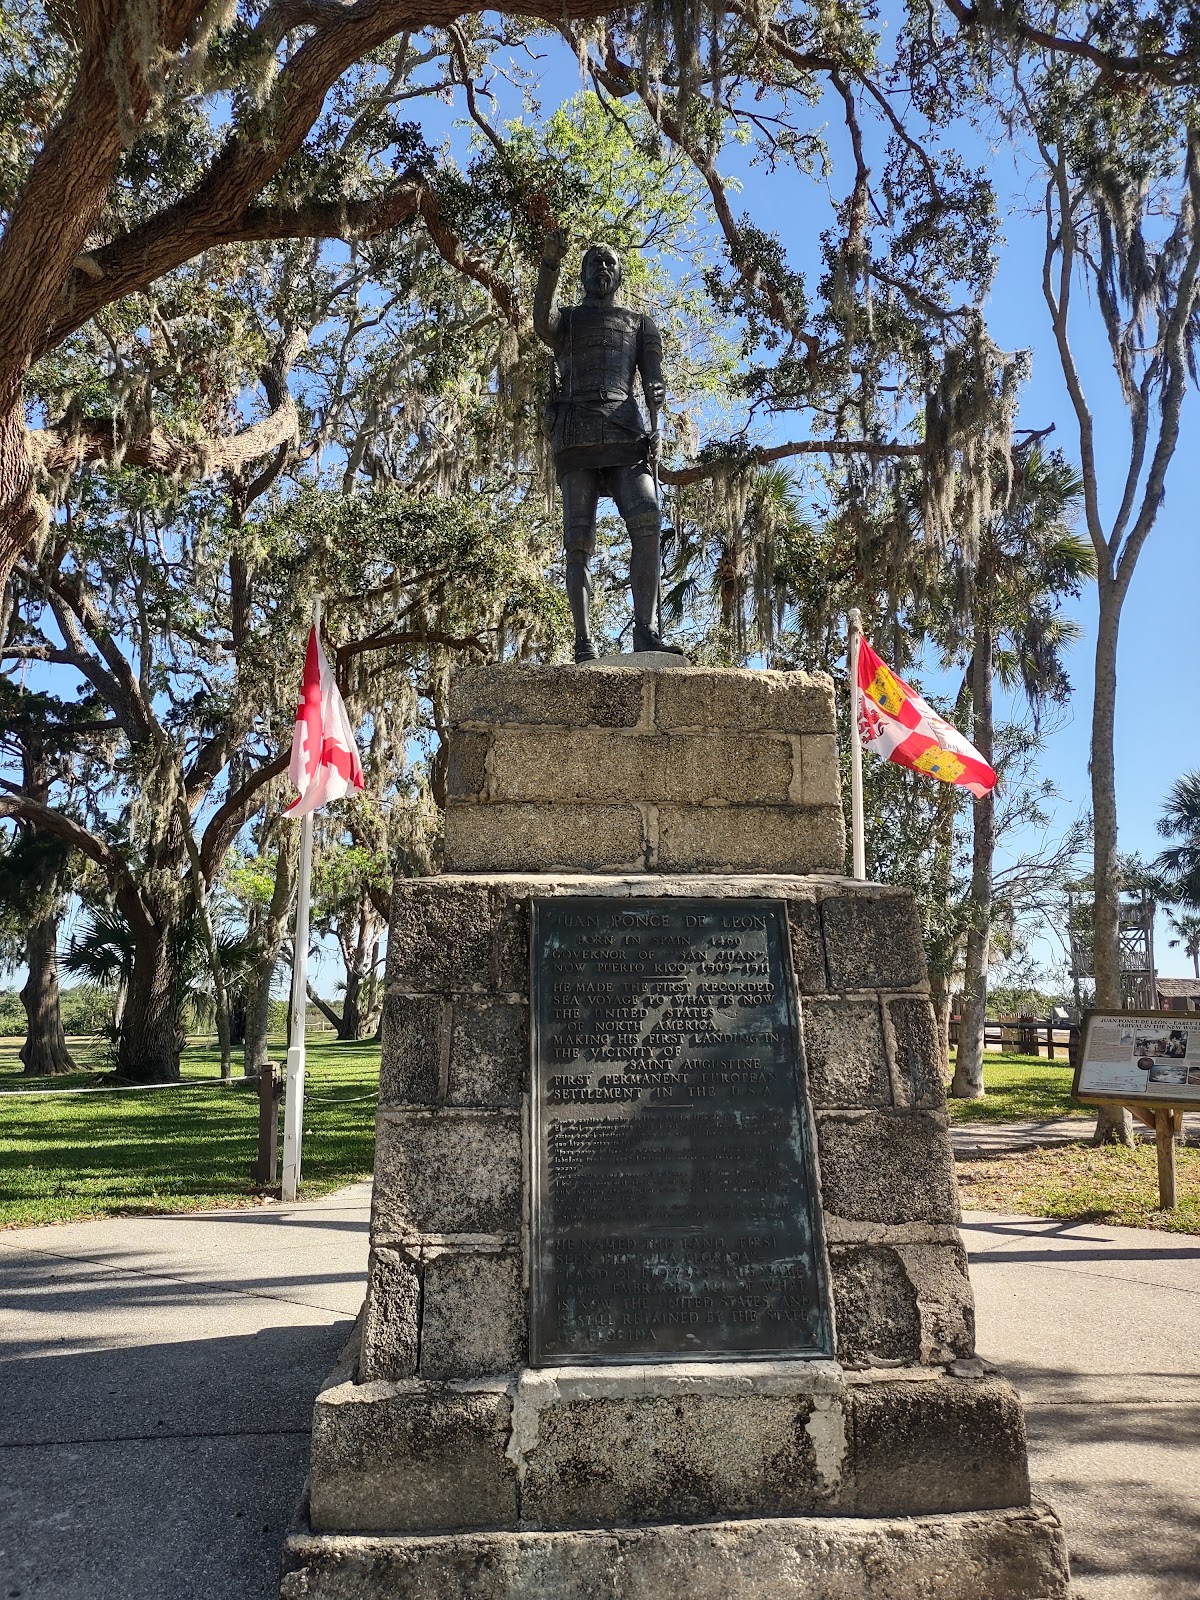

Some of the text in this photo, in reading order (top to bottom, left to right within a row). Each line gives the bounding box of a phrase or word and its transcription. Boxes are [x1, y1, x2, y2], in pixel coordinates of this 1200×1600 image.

[555, 914, 767, 929] JUAN PONCE DE LEON
[577, 935, 743, 946] BORN IN SPAIN 1460
[552, 949, 628, 960] GOVERNOR
[638, 949, 655, 960] OF
[553, 962, 588, 973] NOW
[597, 962, 645, 973] PUERTO
[554, 982, 776, 993] HE MADE THE FIRST RECORDED
[553, 994, 775, 1005] SEA VOYAGE TO WHAT IS NOW
[553, 1007, 715, 1019] THE UNITED STATES
[567, 1021, 585, 1032] OF
[595, 1021, 643, 1032] NORTH
[553, 1032, 780, 1045] MAKING HIS FIRST LANDING IN
[554, 1046, 682, 1058] THE VICINITY OF
[629, 1059, 673, 1070] SAINT
[553, 1072, 777, 1085] FIRST PERMANENT EUROPEAN
[553, 1087, 643, 1099] SETTLEMENT
[656, 1087, 673, 1097] IN
[688, 1086, 716, 1097] THE
[555, 1238, 574, 1250] HE
[580, 1238, 637, 1250] NAMED
[739, 1236, 777, 1248] FIRST
[556, 1253, 593, 1265] SEEN
[615, 1267, 634, 1279] OF
[557, 1279, 806, 1295] LATER EMBRACED ALL OF WHAT
[557, 1299, 570, 1311] IS
[578, 1298, 613, 1310] NOW
[624, 1297, 649, 1309] THE
[656, 1295, 713, 1309] UNITED
[780, 1294, 811, 1307] AND
[558, 1309, 808, 1327] IS STILL RETAINED BY THE STATE
[588, 1328, 660, 1342] FLORIDA
